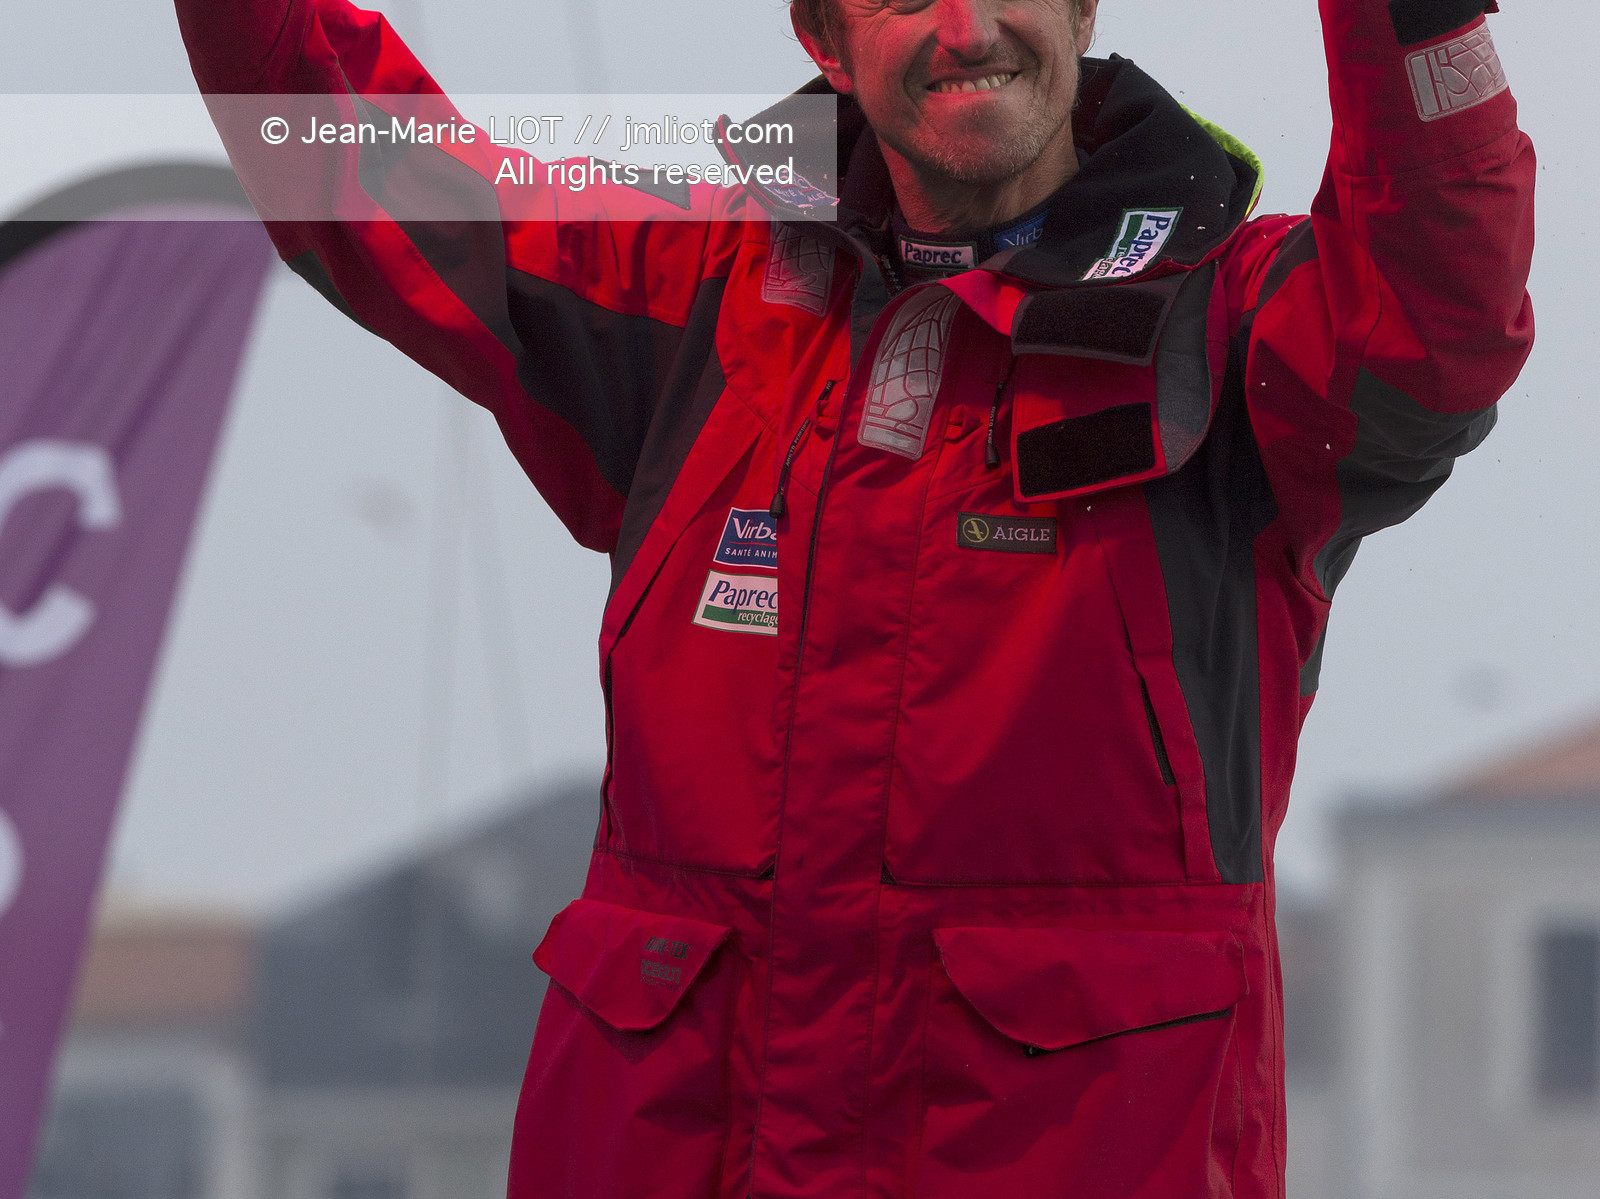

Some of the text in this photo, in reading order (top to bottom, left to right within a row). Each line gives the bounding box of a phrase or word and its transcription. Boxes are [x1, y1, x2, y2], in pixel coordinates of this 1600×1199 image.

[904, 242, 962, 267] Paprec
[1111, 214, 1171, 275] Paprec
[992, 525, 1050, 542] AIGLE
[724, 546, 751, 557] SANTÉ
[708, 579, 778, 615] Paprec
